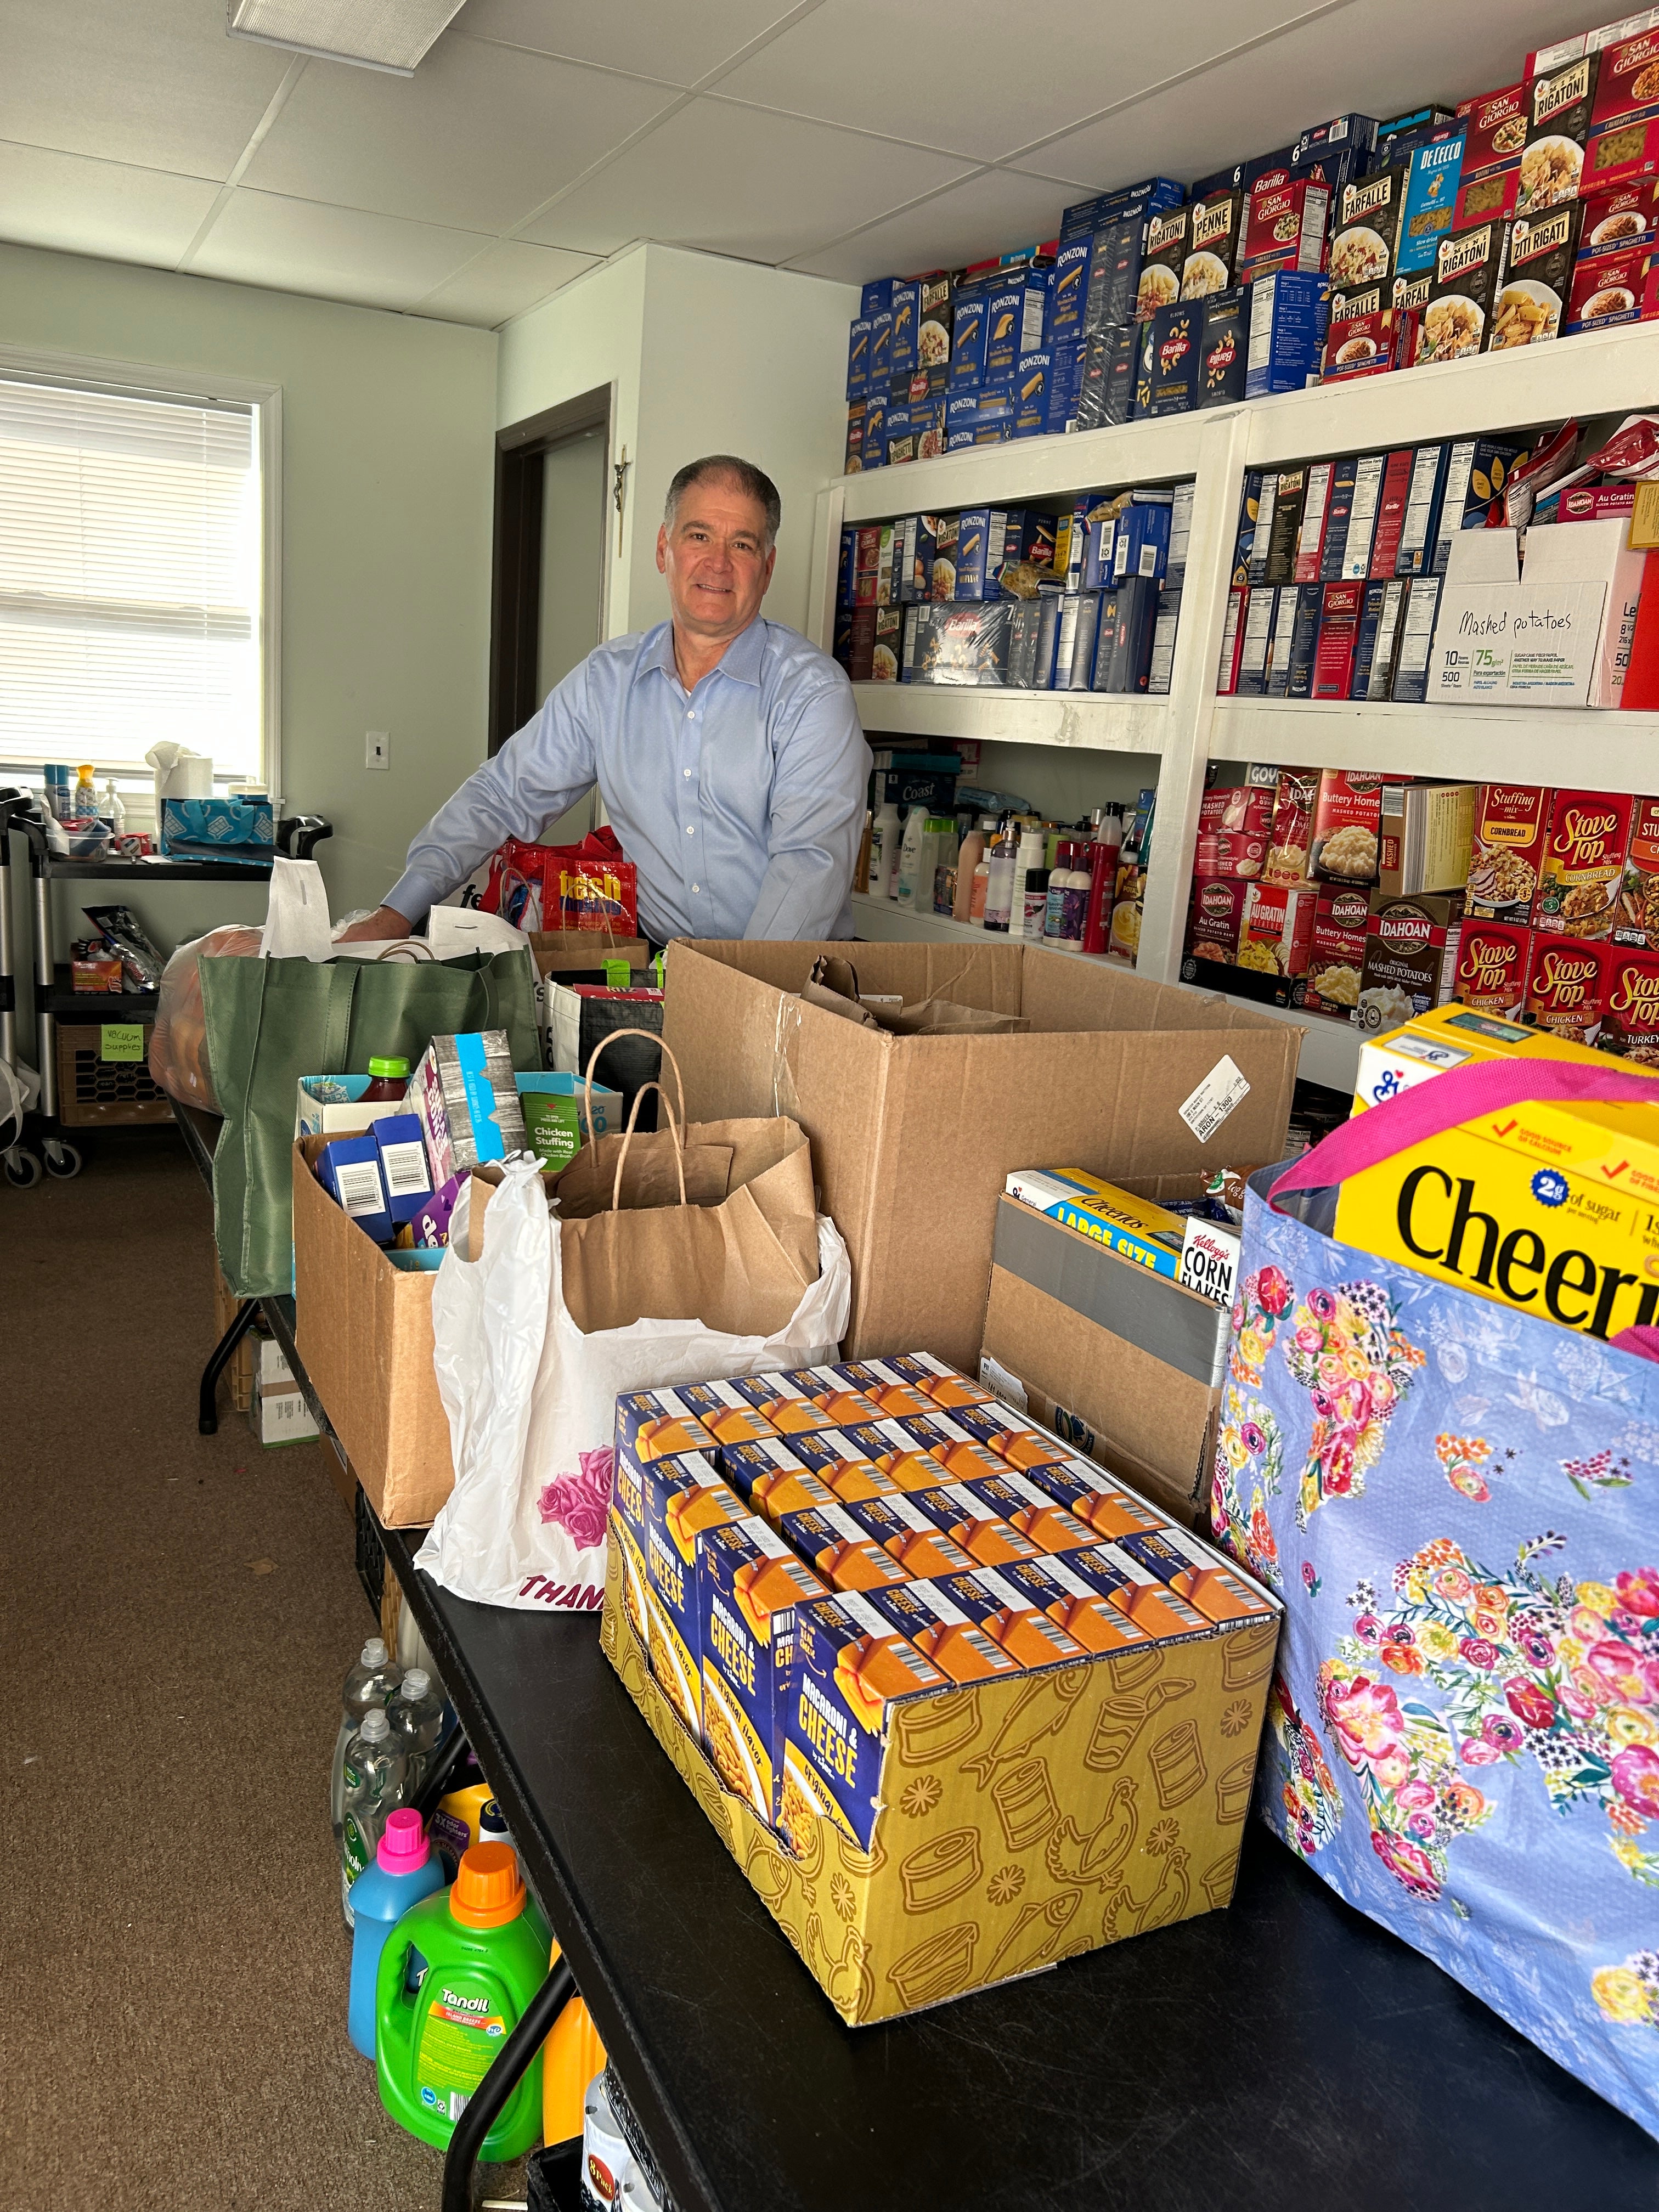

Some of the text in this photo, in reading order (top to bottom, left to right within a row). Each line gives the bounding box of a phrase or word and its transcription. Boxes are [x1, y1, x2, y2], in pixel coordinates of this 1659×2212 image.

[1628, 38, 1650, 55] SAN
[1538, 76, 1584, 116] RIGATONI
[1480, 101, 1519, 128] GIORGIO
[1491, 97, 1509, 114] SAN
[1292, 144, 1300, 162] 6
[1433, 140, 1462, 166] CECCO
[1234, 166, 1240, 184] 6
[1254, 173, 1286, 194] Barilla
[1267, 194, 1282, 208] SAN
[1345, 183, 1389, 220] FARFALLE
[1609, 195, 1639, 213] GIORGIO
[1618, 193, 1632, 202] SAN
[1257, 199, 1290, 221] GIORGIO
[1196, 207, 1228, 235] PENNE
[1150, 221, 1183, 249] RIGATONI
[1196, 224, 1228, 242] RIGATE
[1514, 221, 1565, 257] ZITI RIGATI
[1454, 234, 1487, 255] MINI
[1592, 235, 1646, 255] POT-SIZED SPAGHETTI
[1057, 247, 1088, 268] RONZONI
[1442, 240, 1486, 275] RIGATONI
[1598, 272, 1627, 288] GIORGIO
[893, 291, 915, 307] RONZONI
[991, 295, 1020, 314] RONZONI
[956, 303, 984, 321] RONZONI
[1334, 295, 1377, 323] FARFALLE
[851, 321, 872, 337] RONZONI
[1582, 312, 1634, 329] POT-SIZED SPAGHETTI
[1348, 324, 1370, 337] GIORGIO
[1162, 343, 1187, 356] Barilla
[1209, 351, 1233, 364] Barilla
[1018, 354, 1051, 373] RONZONI
[1336, 358, 1378, 373] POT-SIZED SPAGHETTI
[867, 396, 888, 411] RONZONI
[950, 398, 977, 414] RONZONI
[887, 413, 909, 427] RONZONI
[948, 431, 974, 447] RONZONI
[1280, 477, 1302, 492] RIGATONI
[1567, 493, 1634, 509] IDAHOAN Au Gratin
[961, 516, 986, 531] RONZONI
[1031, 546, 1054, 557] Barilla
[1328, 598, 1353, 608] GIORGIO
[949, 618, 981, 632] Barilla
[1459, 609, 1572, 639] Mashed potatoes
[1444, 650, 1459, 666] 10
[1476, 649, 1493, 667] 75
[1442, 672, 1460, 682] 500
[902, 782, 935, 801] Coast
[1322, 792, 1352, 807] Buttery
[1491, 788, 1536, 812] Stuffing
[1332, 808, 1354, 816] MASHED
[1504, 805, 1519, 814] mix
[1490, 826, 1526, 838] CORNBREAD
[1554, 809, 1618, 853] Stove
[902, 843, 917, 854] Dove
[1386, 839, 1395, 867] MASHED
[1570, 838, 1605, 865] Top
[1565, 868, 1616, 883] CORNBREAD
[559, 870, 622, 901] fresh
[1203, 894, 1233, 906] IDAHOAN
[1250, 903, 1285, 924] AU GRATIN
[1331, 904, 1368, 917] IDAHOAN
[1198, 916, 1230, 930] Au Gratin
[1250, 919, 1283, 931] POTATOES
[1379, 919, 1431, 939] IDAHOAN
[1316, 925, 1342, 940] Buttery
[1316, 939, 1336, 947] MASHED
[1389, 960, 1409, 969] ORIGINAL
[1460, 938, 1517, 978] Stove
[1367, 961, 1396, 975] MASHED
[1397, 967, 1432, 983] POTATOES
[1475, 968, 1506, 991] Top
[1532, 952, 1598, 995] Stove
[1304, 995, 1310, 1003] 8
[1471, 996, 1505, 1007] CHICKEN
[1550, 984, 1585, 1008] Top
[1546, 1014, 1583, 1025] CHICKEN
[1198, 1116, 1216, 1137] ARON
[1218, 1096, 1233, 1112] 1300
[534, 1127, 574, 1138] Chicken
[1519, 1128, 1572, 1153] GOOD SOURCE
[535, 1136, 574, 1149] Stuffing
[1537, 1176, 1621, 1222] 2g of sugar
[1081, 1198, 1149, 1229] Cheerios
[1193, 1234, 1229, 1261] Kellogg's
[1184, 1246, 1233, 1292] CORN
[620, 1448, 643, 1493] MACARONI
[649, 1521, 676, 1573] MACARONI
[649, 1538, 685, 1613] CHEESE
[951, 1576, 984, 1601] CHEESE
[812, 1601, 844, 1629] CHEESE
[712, 1593, 755, 1661] MACARONI &
[654, 1595, 693, 1679] original flavor
[710, 1613, 756, 1697] CHEESE
[803, 1672, 858, 1750] MACARONI &
[718, 1675, 763, 1768] original flavor
[798, 1694, 858, 1789] CHEESE
[805, 1762, 834, 1815] original
[435, 1812, 460, 1829] 3X odor
[445, 1824, 468, 1838] fighters
[442, 1988, 489, 2013] Tandil
[445, 2012, 482, 2025] ISLAND BREEZE
[589, 2159, 613, 2197] 8 Pack
